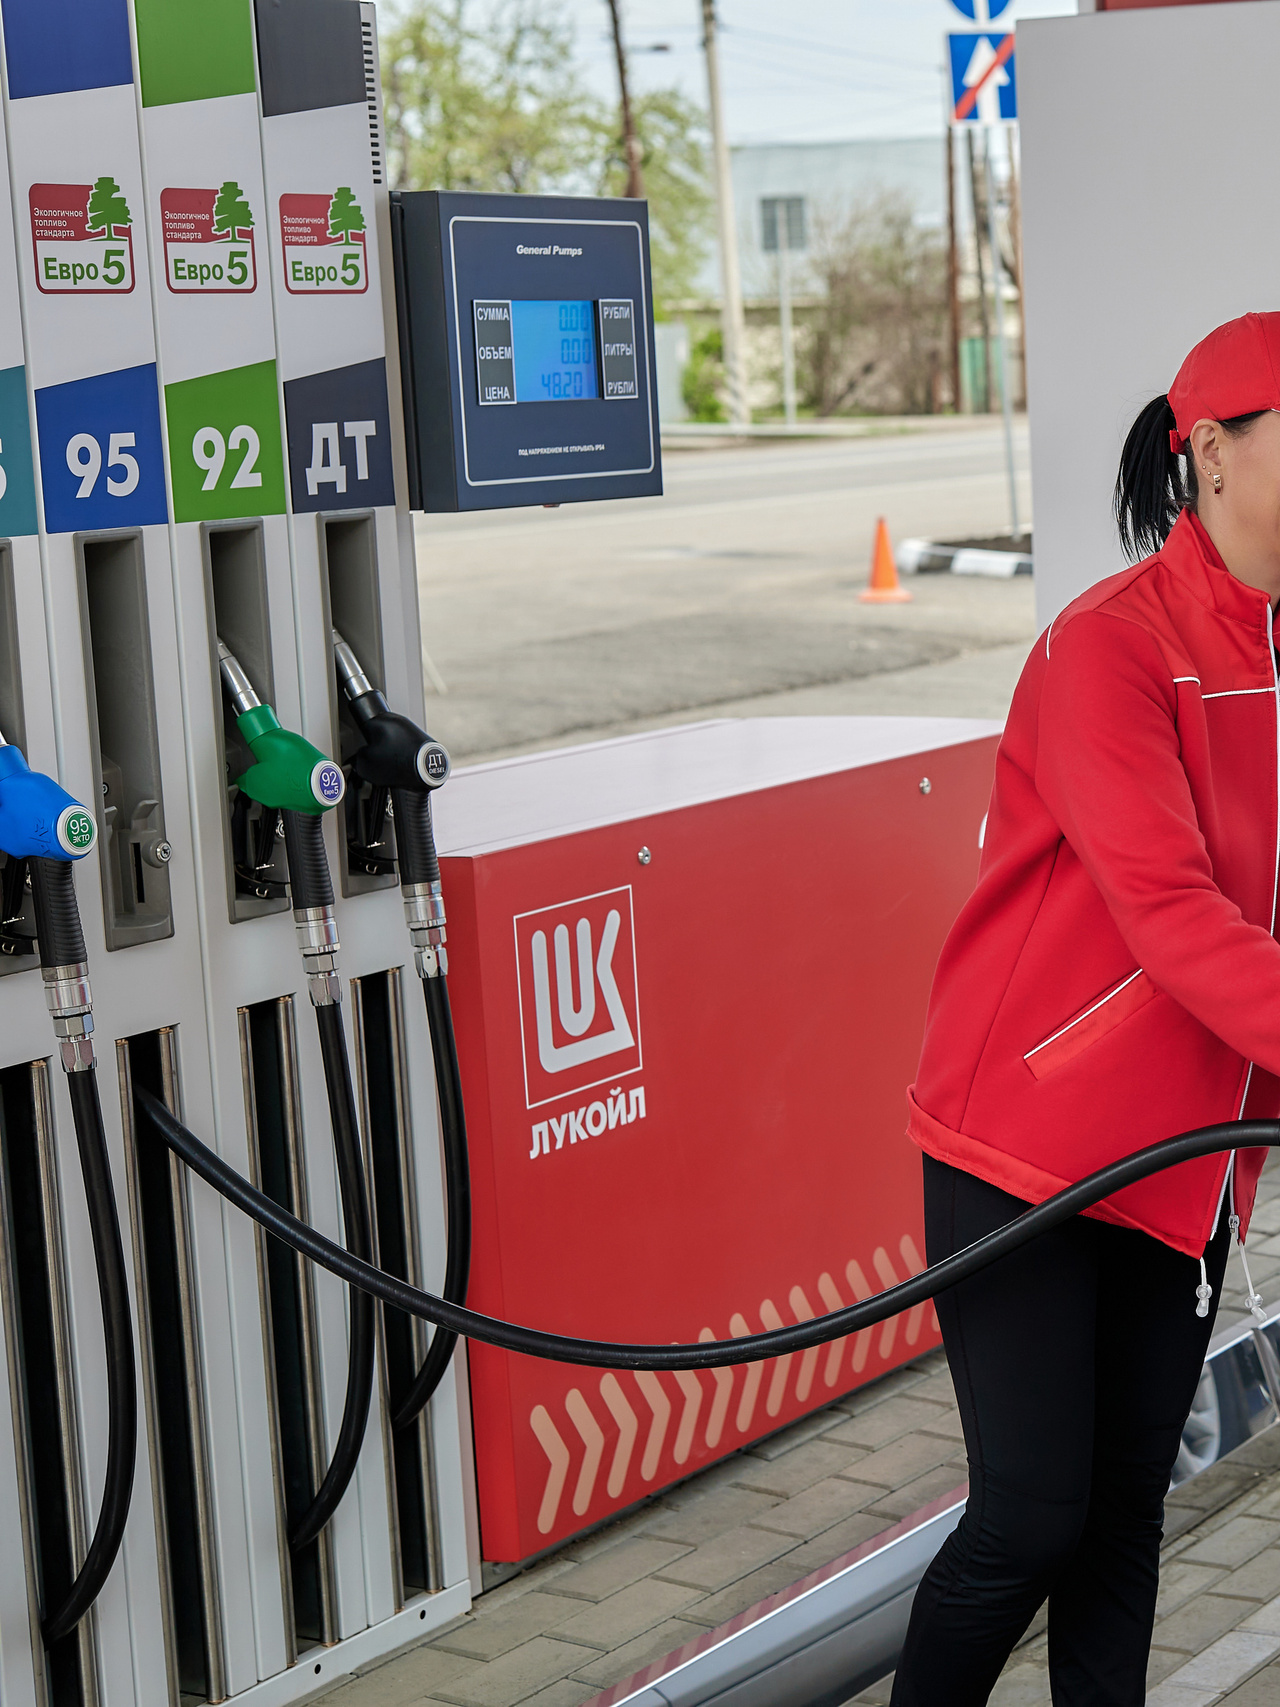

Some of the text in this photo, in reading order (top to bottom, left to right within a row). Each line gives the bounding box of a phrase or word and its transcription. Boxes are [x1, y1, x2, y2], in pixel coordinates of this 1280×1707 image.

[33, 207, 83, 217] Экологичное
[164, 210, 210, 220] Экологичное
[34, 219, 67, 227] топливо
[283, 215, 325, 224] Экологичное
[35, 229, 75, 238] стандарта
[166, 231, 202, 240] стандарта
[284, 235, 318, 243] стандарта
[516, 244, 583, 258] General Pumps
[43, 249, 125, 285] Евро 5
[173, 251, 248, 285] Евро 5
[291, 253, 360, 286] Евро 5
[477, 307, 510, 321] СУММА
[603, 306, 631, 319] РУБЛИ
[479, 346, 512, 360] ОБЪЕМ
[604, 343, 633, 356] ЛИТРЫ
[485, 386, 511, 401] ЦЕНА
[608, 381, 635, 394] РУБЛИ
[192, 425, 262, 491] 92
[305, 420, 376, 496] ДТ
[65, 432, 140, 499] 95
[428, 753, 443, 769] ДТ
[321, 771, 338, 787] 92
[334, 786, 339, 795] 5
[70, 817, 89, 835] 95
[72, 834, 90, 844] ЭКТО
[531, 909, 635, 1074] LUK
[529, 1086, 647, 1160] ЛУКОЙЛ
